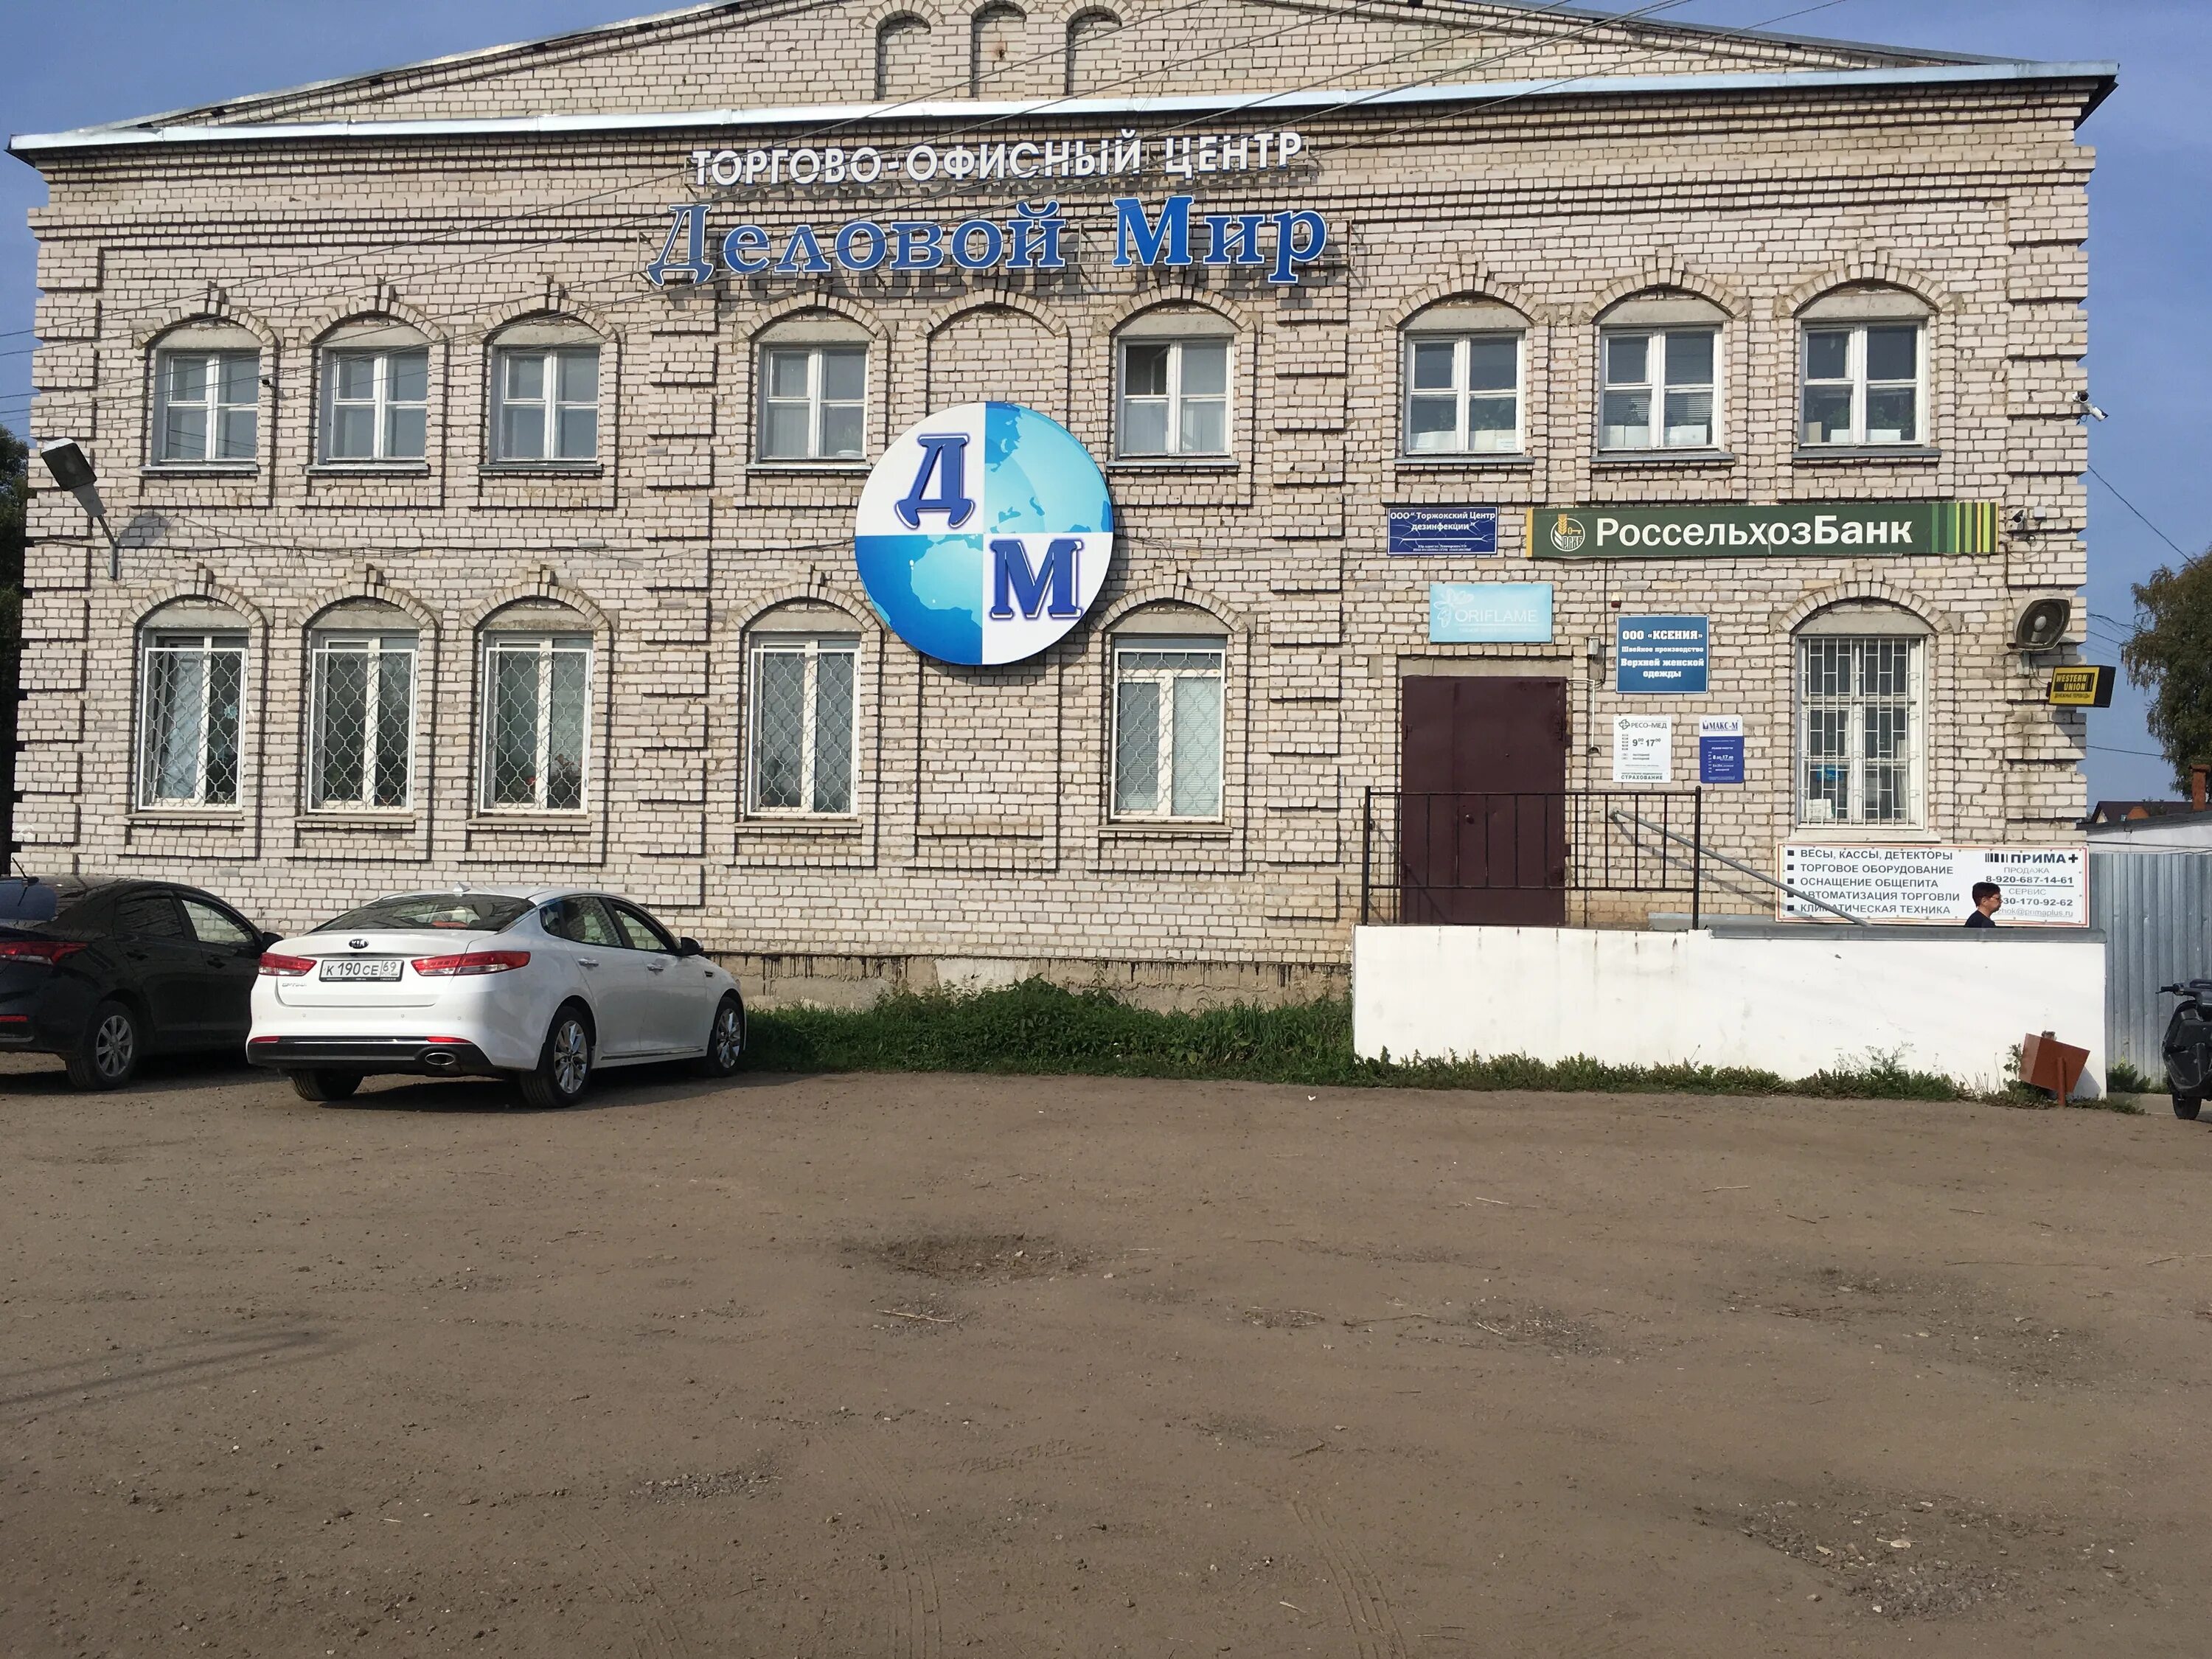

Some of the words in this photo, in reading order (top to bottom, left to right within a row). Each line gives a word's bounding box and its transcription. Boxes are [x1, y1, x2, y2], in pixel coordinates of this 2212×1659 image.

[692, 128, 1141, 187] ТОРГОВО-ОФИСНЫЙ
[1164, 131, 1303, 181] ЦЕНТР
[646, 200, 1067, 288] Деловой
[1111, 195, 1329, 285] Мир
[894, 433, 975, 529] Д
[1390, 512, 1410, 520] ООО
[1470, 511, 1495, 521] Центр
[1596, 515, 1913, 546] РоссельхозБанк
[990, 539, 1084, 620] М
[1455, 609, 1538, 622] ORIFLAME
[1622, 630, 1644, 640] ООО
[1647, 630, 1703, 640] «КСЕНИЯ»
[1621, 658, 1660, 668] Верхней
[1663, 658, 1705, 667] женской
[1643, 670, 1682, 679] одежды
[2056, 674, 2088, 683] WESTERN
[2063, 683, 2087, 691] UNION
[1709, 722, 1738, 730] МАКС-М
[1801, 849, 1836, 859] ВЕСЫ,
[1839, 850, 1882, 860] КАССЫ,
[1885, 851, 1953, 860] ДЕТЕКТОРЫ
[1801, 863, 1859, 873] ТОРГОВОЕ
[1862, 864, 1954, 874] ОБОРУДОВАНИЕ
[1800, 877, 1872, 888] ОСНАЩЕНИЕ
[1875, 878, 1938, 888] ОБЩЕПИТА
[1986, 875, 2073, 884] 8-920-687-14-61
[1901, 891, 1960, 901] ТОРГОВЛИ
[2003, 897, 2073, 906] 30-170-92-62
[1899, 905, 1951, 914] ТЕХНИКА
[383, 961, 397, 973] 69
